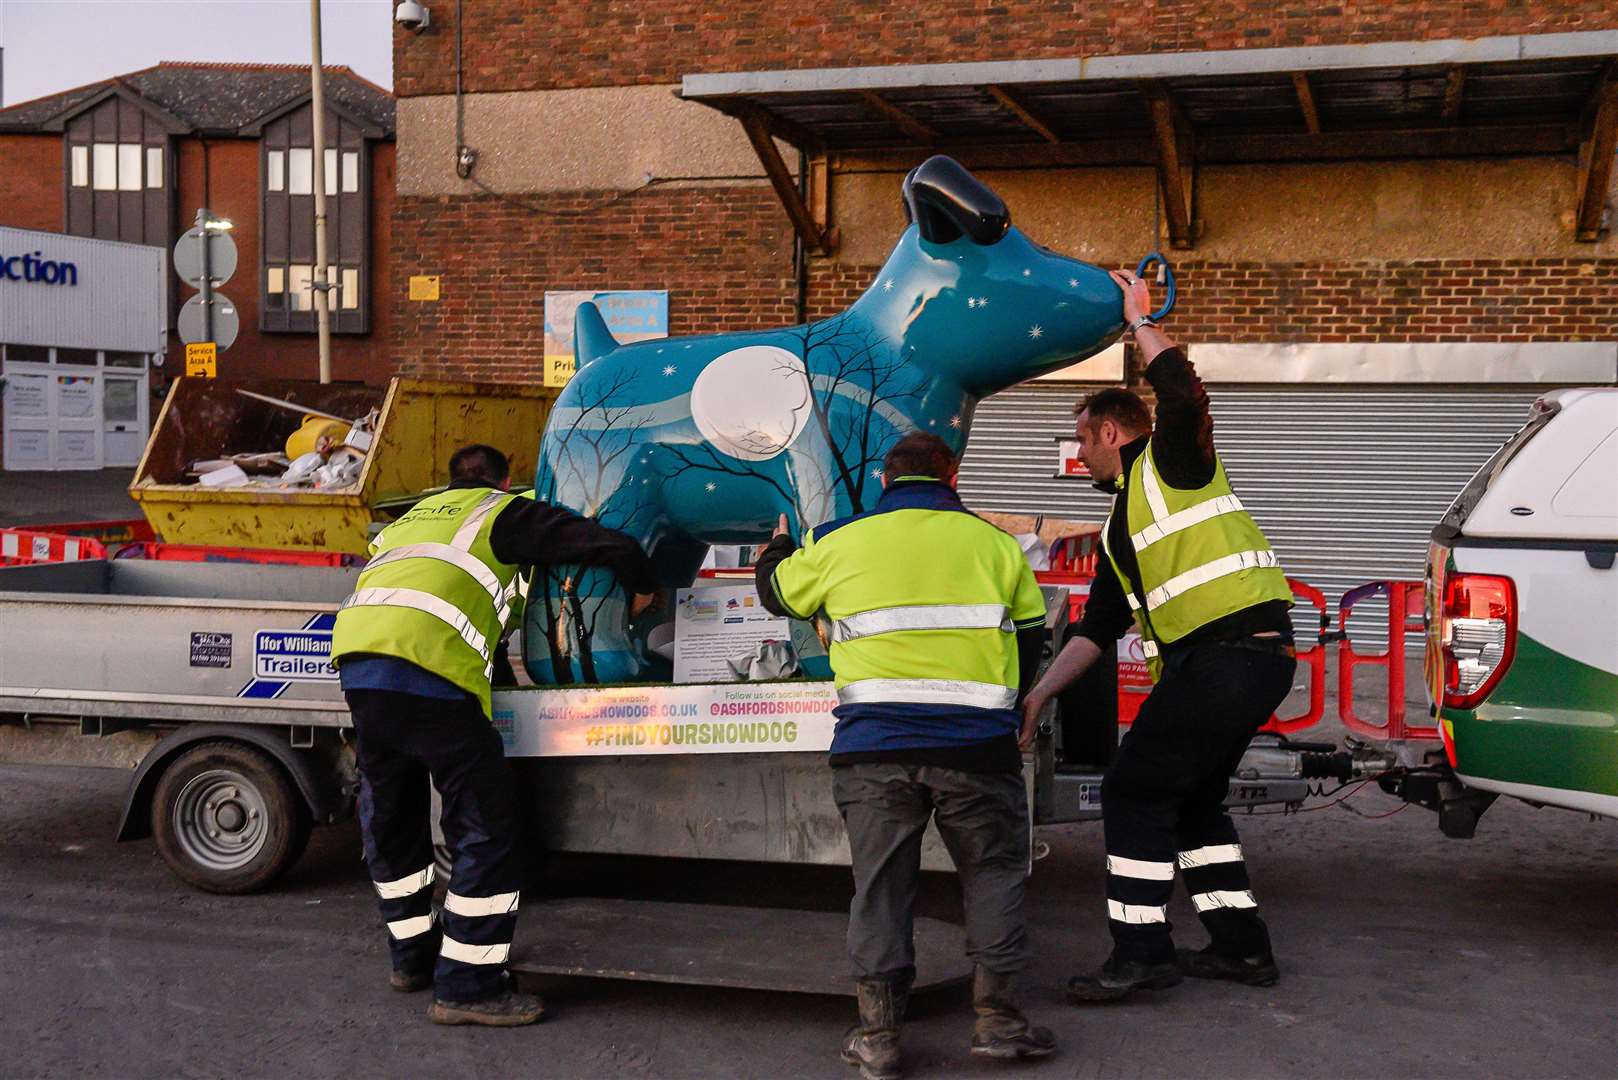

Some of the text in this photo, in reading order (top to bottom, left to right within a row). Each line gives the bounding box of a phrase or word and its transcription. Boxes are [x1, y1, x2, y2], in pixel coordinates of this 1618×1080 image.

[0, 251, 78, 286] ction
[260, 636, 282, 651] Ifor
[260, 657, 338, 674] Trailers
[725, 692, 751, 700] Follow
[754, 692, 763, 700] us
[778, 690, 802, 699] social
[804, 689, 831, 698] media
[586, 721, 798, 746] #FINDYOURSNOWDOG
